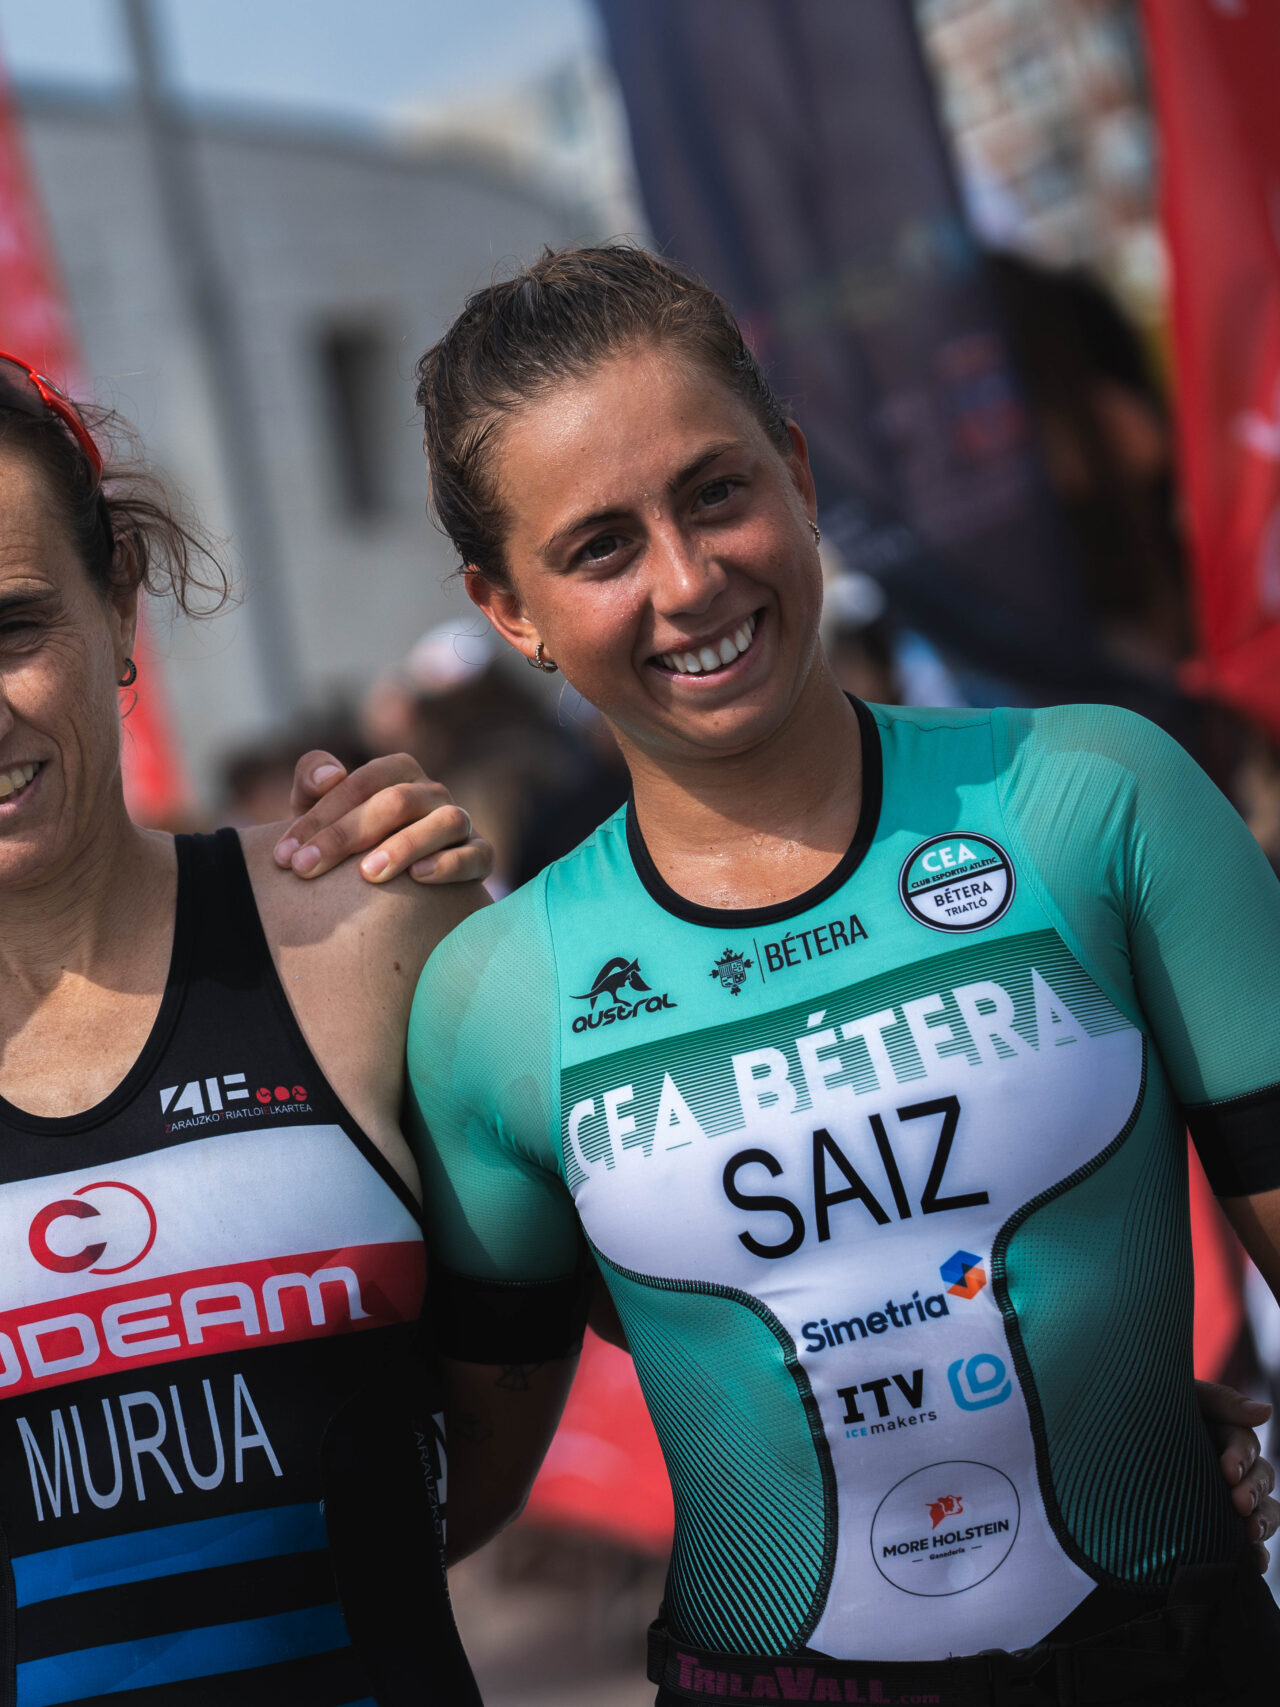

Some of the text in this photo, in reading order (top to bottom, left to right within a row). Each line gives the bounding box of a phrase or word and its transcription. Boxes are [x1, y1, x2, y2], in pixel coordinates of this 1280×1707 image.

[911, 879, 931, 889] CLUB
[932, 866, 968, 882] ESPORTIU
[922, 843, 977, 872] CEA
[934, 881, 993, 907] BÉTERA
[945, 897, 988, 917] TRIATLÓ
[764, 914, 868, 974] BÉTERA
[572, 998, 677, 1034] austral
[568, 967, 1094, 1180] CEA BÉTERA
[722, 1095, 990, 1260] SAIZ
[800, 1292, 950, 1354] Simetría
[836, 1368, 925, 1425] ITV
[16, 1373, 283, 1523] MURUA
[882, 1519, 1010, 1558] MORE HOLSTEIN
